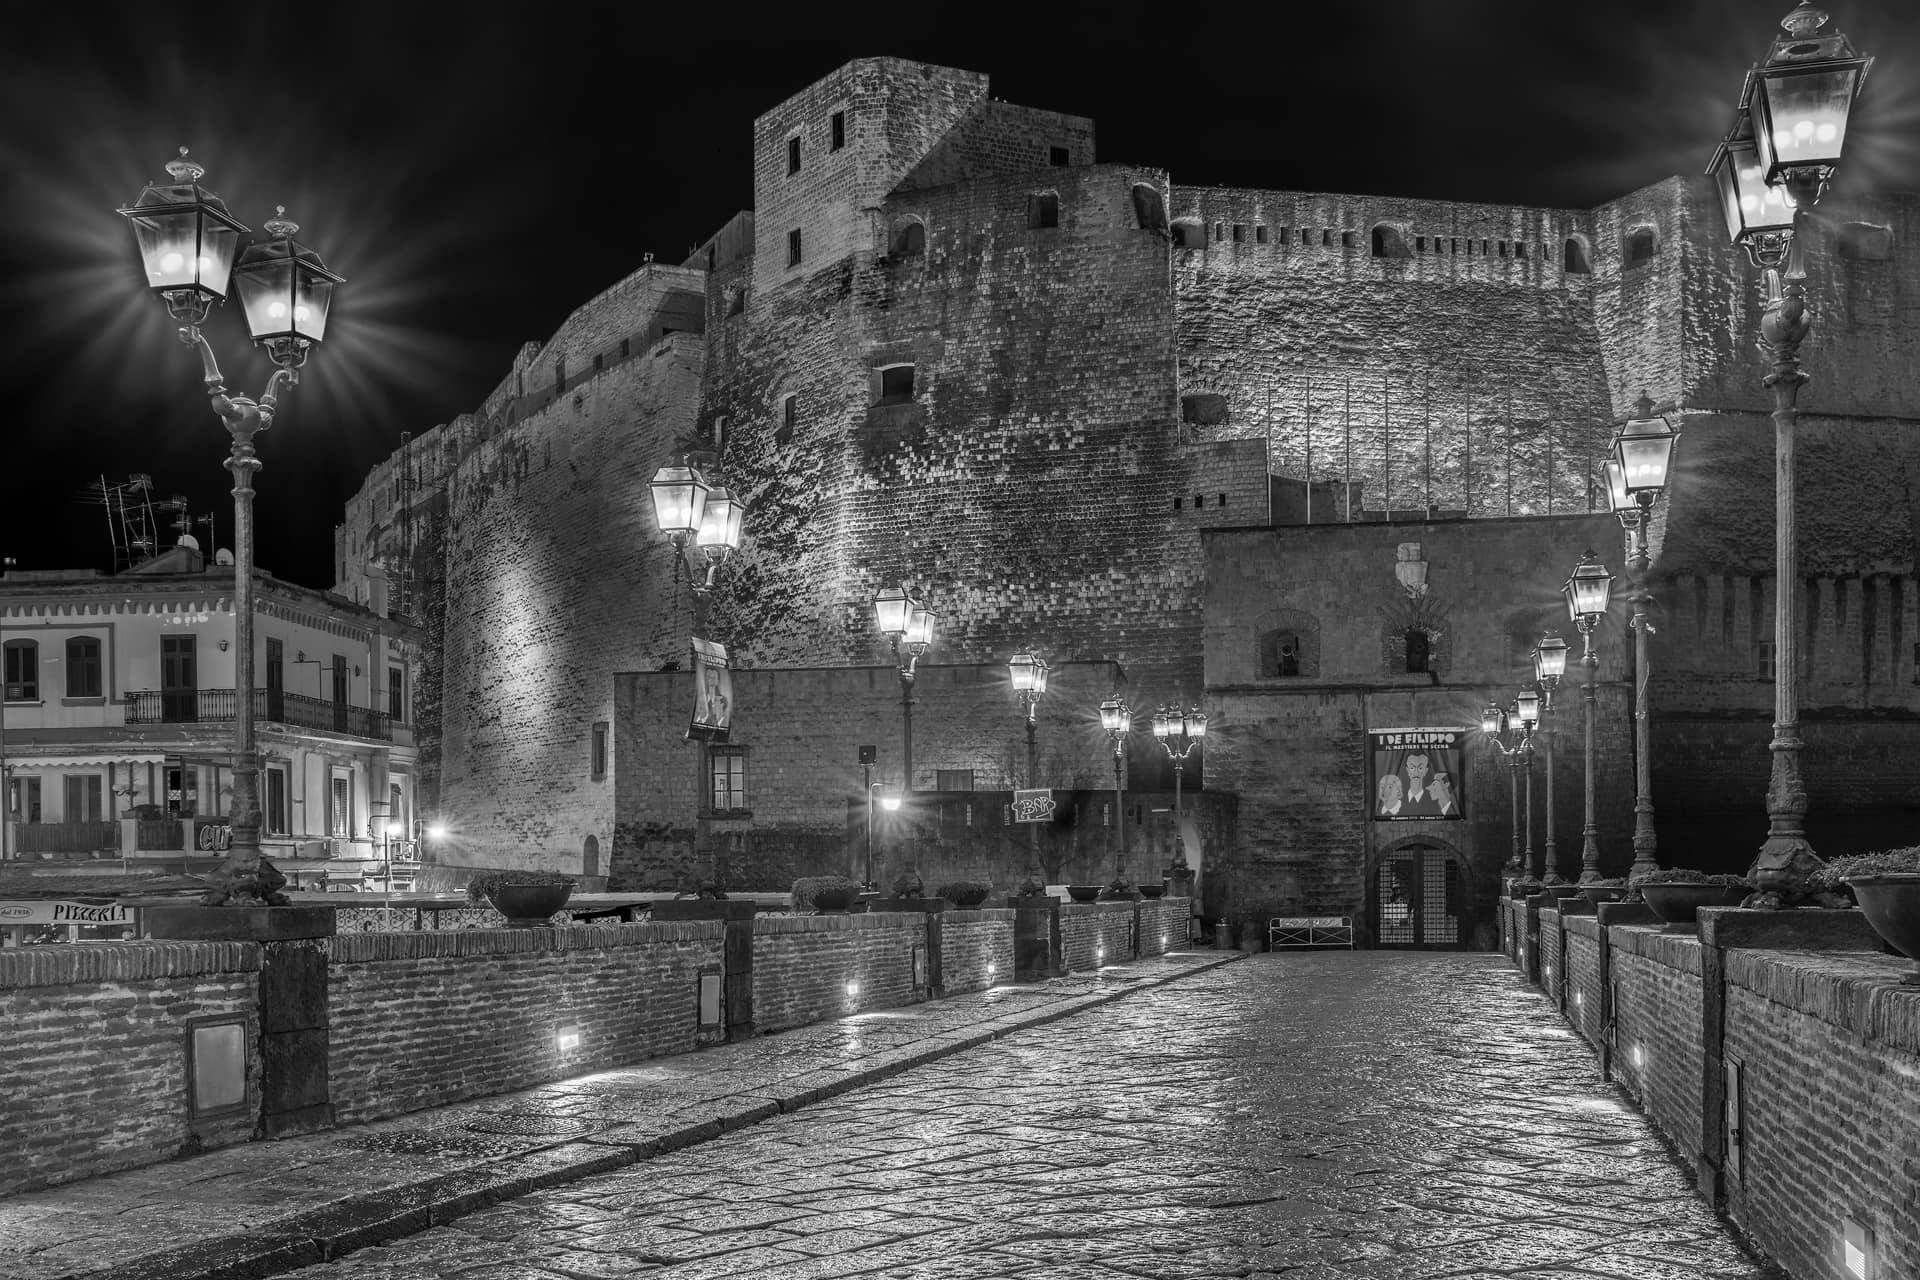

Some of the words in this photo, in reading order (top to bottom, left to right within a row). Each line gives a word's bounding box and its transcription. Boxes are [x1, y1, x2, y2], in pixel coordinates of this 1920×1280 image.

[1387, 734, 1402, 745] DE
[1405, 733, 1455, 744] FILIPPO
[1020, 796, 1050, 815] BAR
[53, 904, 126, 922] PIZZERIA
